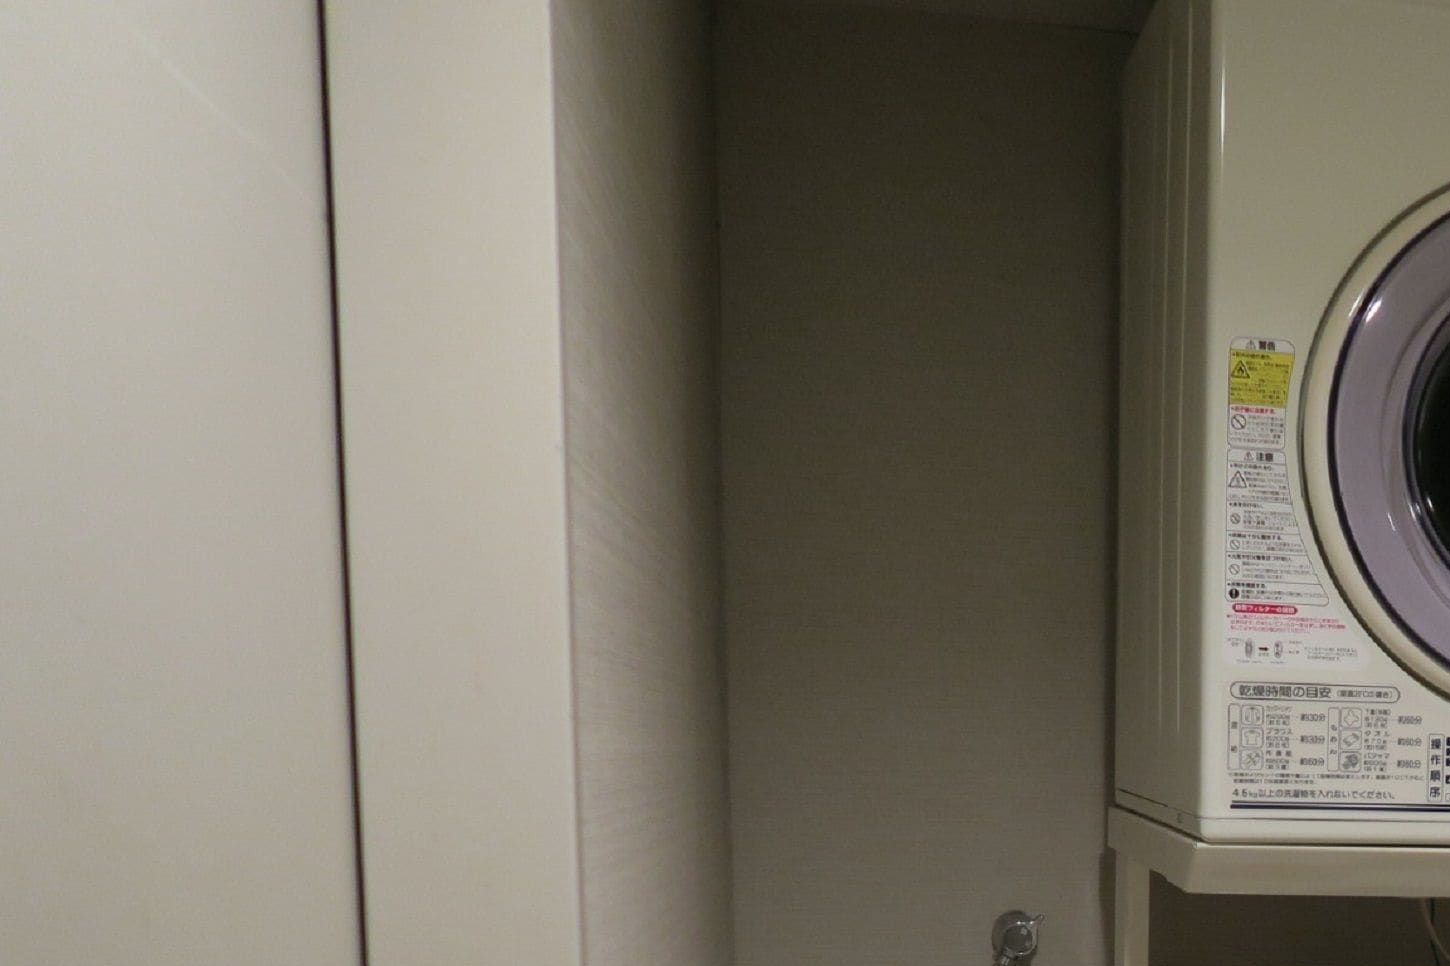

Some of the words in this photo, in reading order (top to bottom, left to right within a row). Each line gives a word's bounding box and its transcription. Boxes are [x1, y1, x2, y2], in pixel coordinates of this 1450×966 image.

[1239, 685, 1332, 699] 乾燥時間の目安
